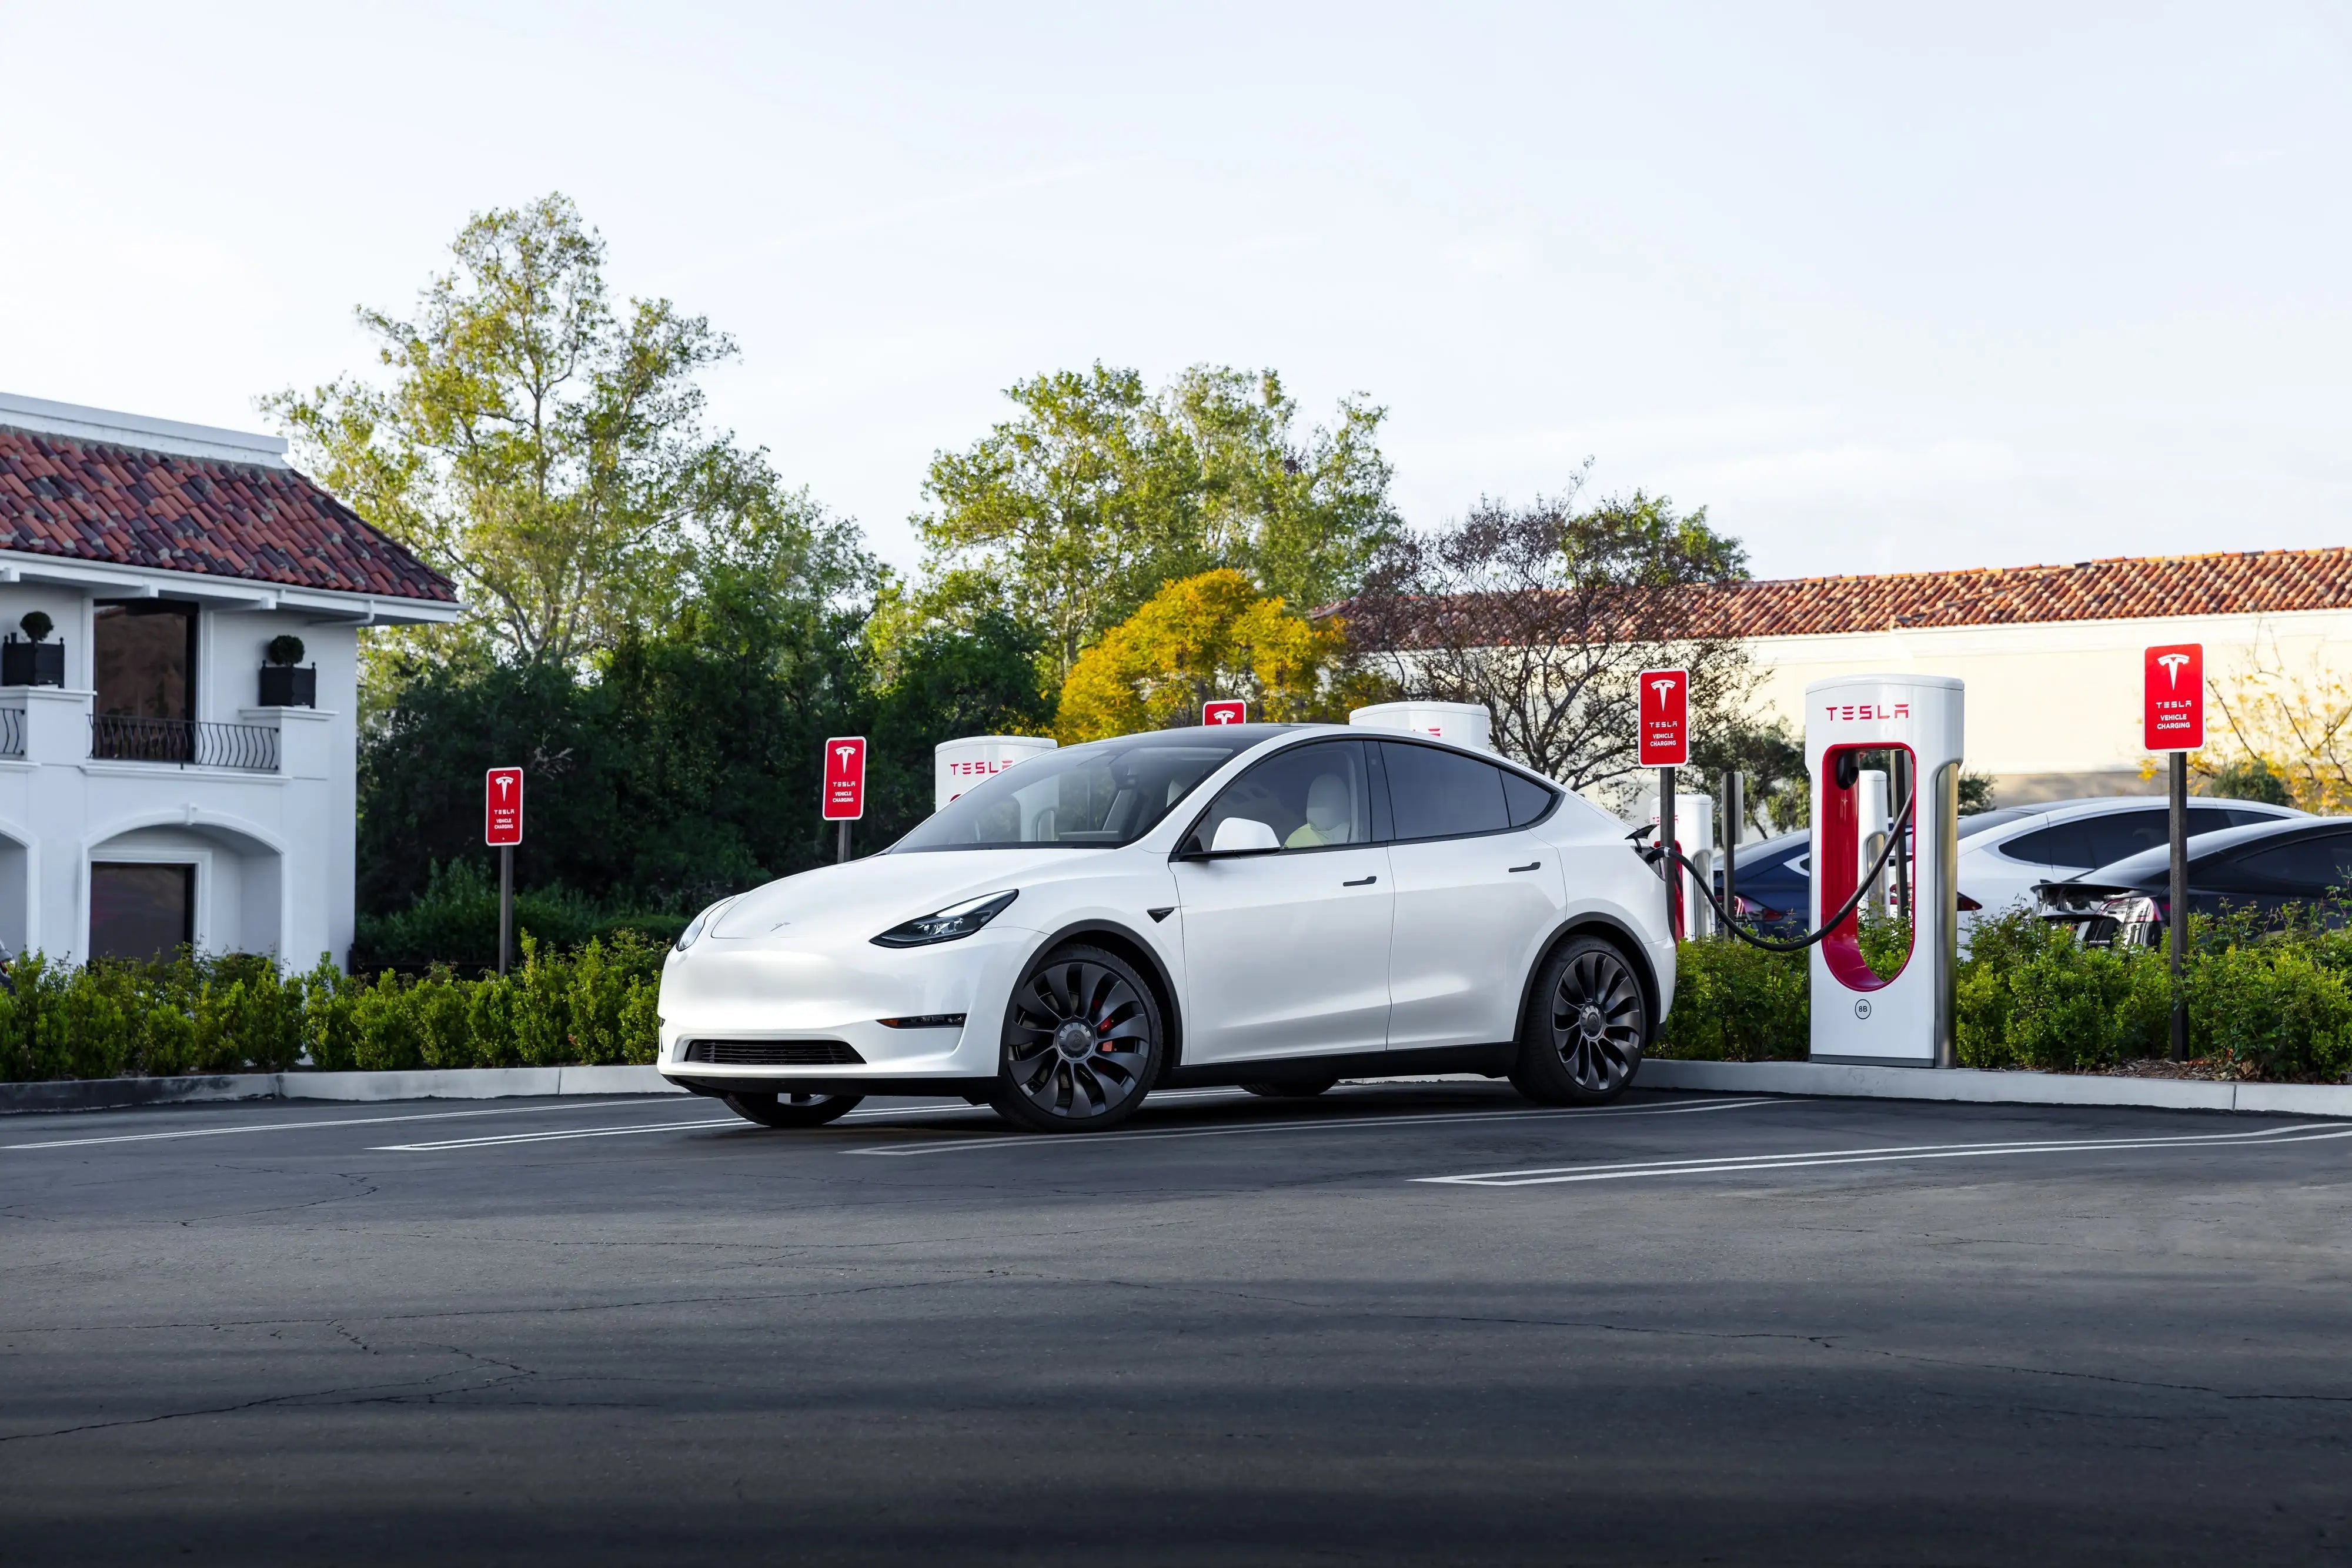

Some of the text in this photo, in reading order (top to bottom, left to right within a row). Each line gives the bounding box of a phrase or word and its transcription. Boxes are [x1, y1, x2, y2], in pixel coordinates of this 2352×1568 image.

[2156, 700, 2192, 709] TESLA
[1826, 704, 1909, 721] TESLA
[2160, 713, 2187, 721] VEHICLE
[2157, 721, 2190, 730] CHARGING
